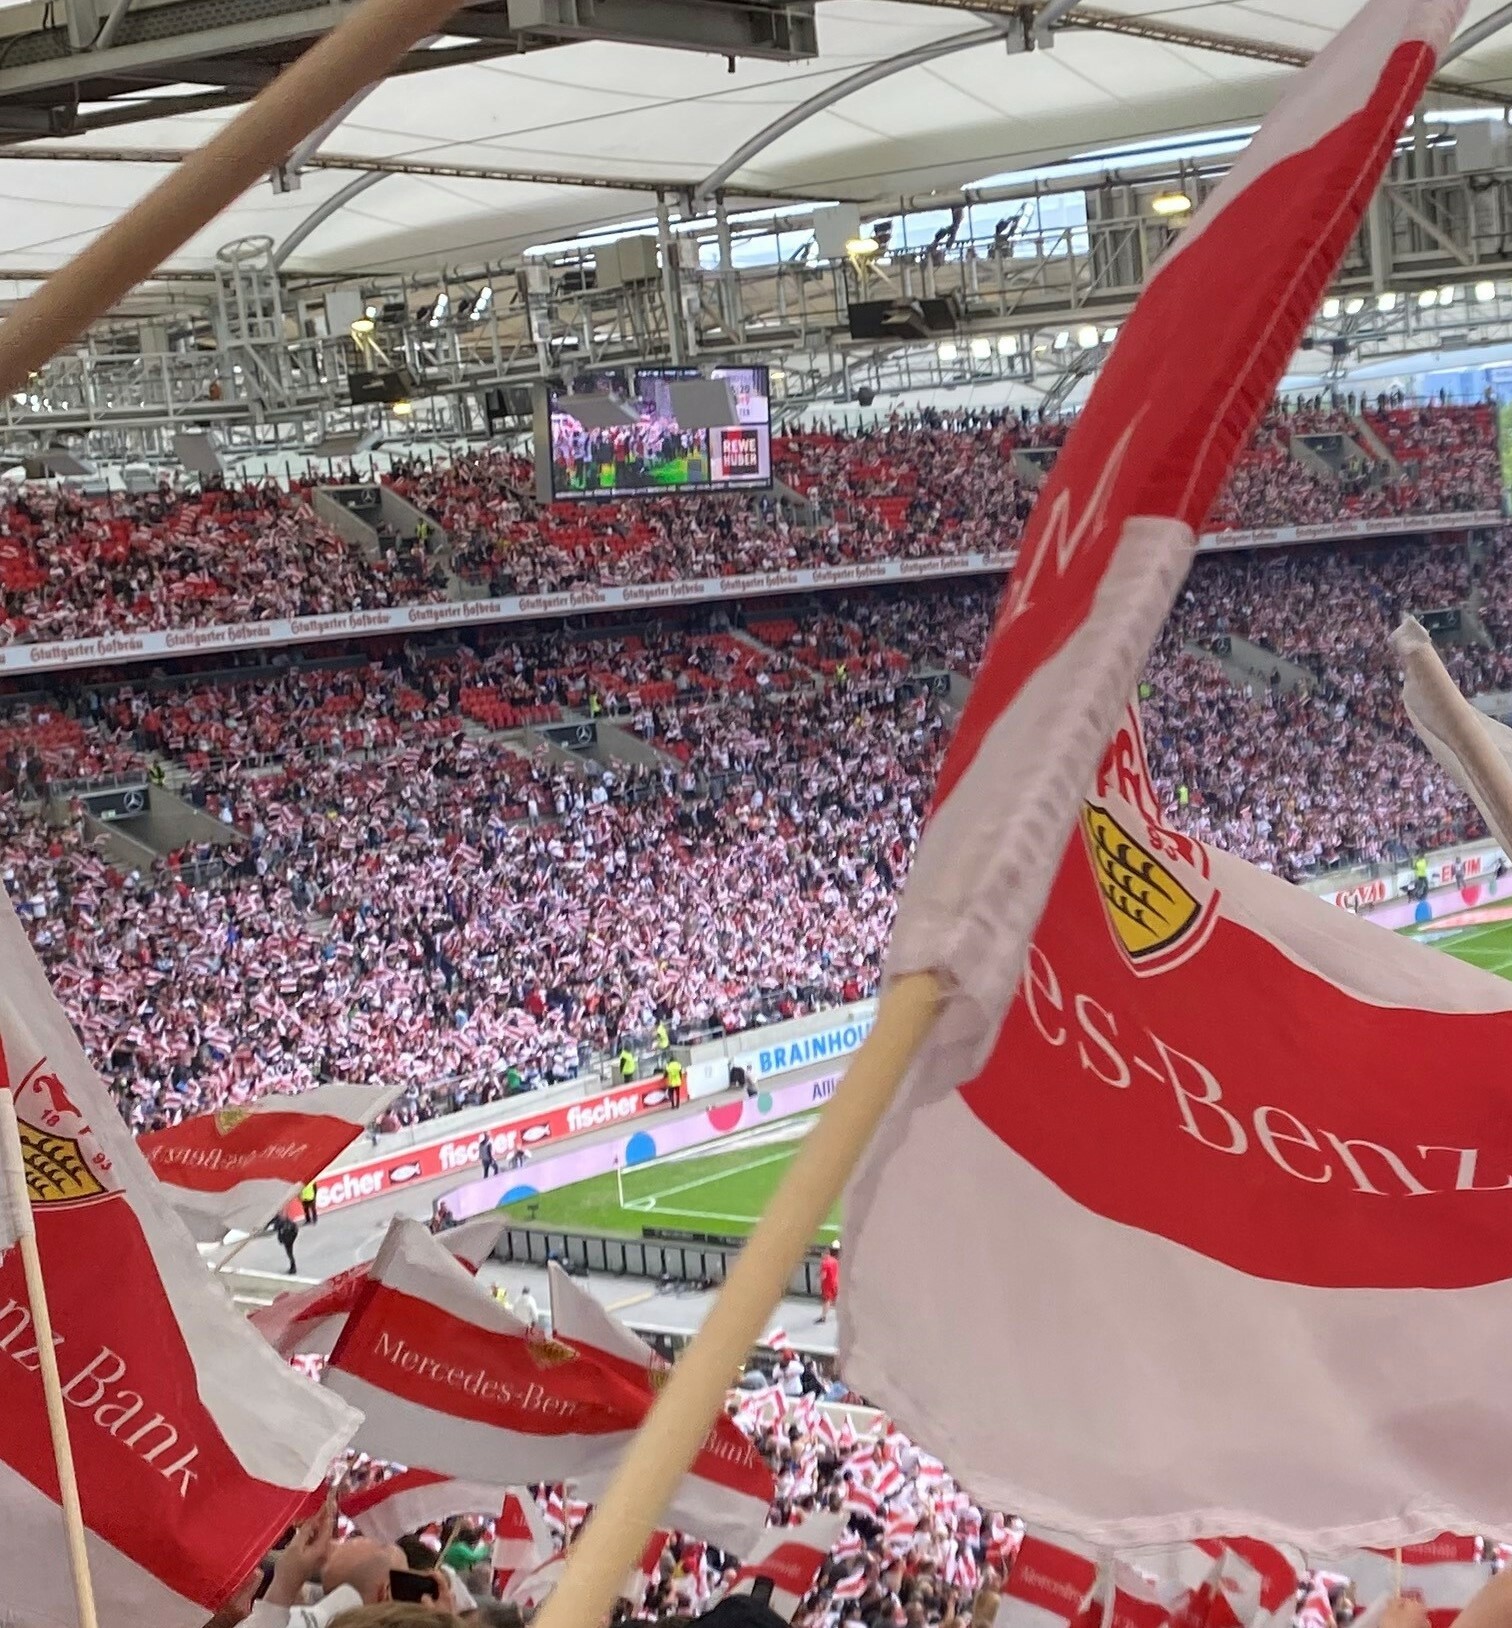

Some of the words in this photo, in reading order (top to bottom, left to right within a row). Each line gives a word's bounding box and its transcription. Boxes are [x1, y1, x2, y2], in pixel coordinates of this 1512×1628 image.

[567, 1093, 639, 1132] fischer
[439, 1130, 518, 1171] fiscer
[315, 1169, 384, 1208] scher
[373, 1331, 578, 1417] Mercedes-Ben
[61, 1345, 199, 1498] Bank
